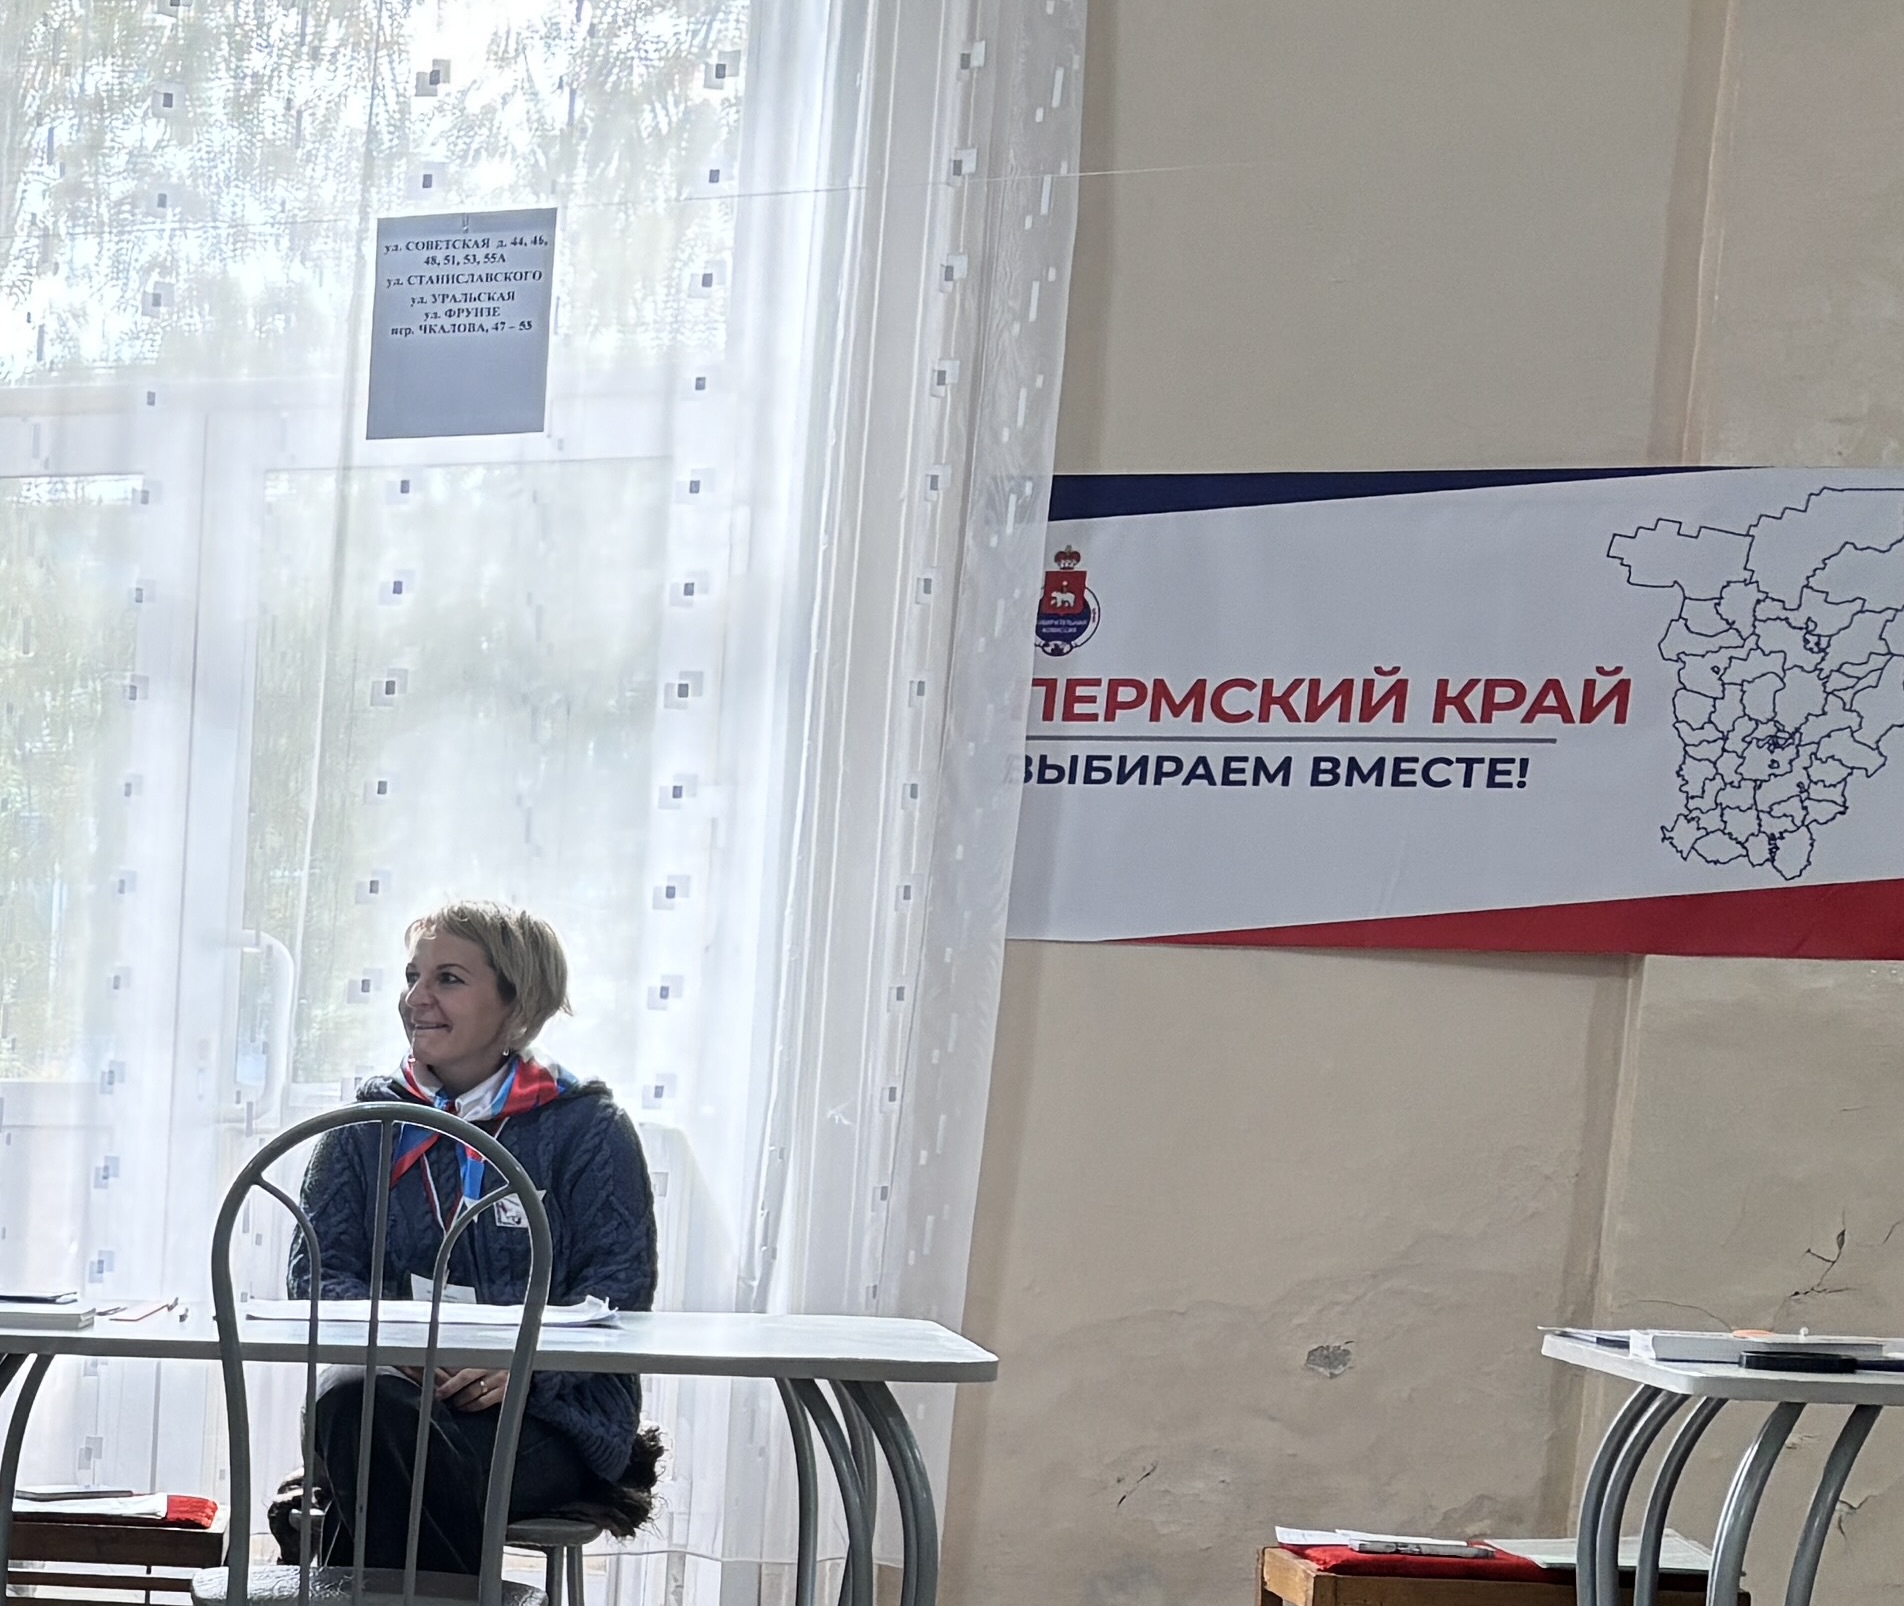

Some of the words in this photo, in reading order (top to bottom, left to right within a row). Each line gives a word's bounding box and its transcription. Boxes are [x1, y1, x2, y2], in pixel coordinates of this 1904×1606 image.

[405, 238, 490, 252] СОВЕТСКАЯ
[407, 270, 543, 286] СТАНИСЛАВСКОГО
[431, 291, 516, 304] УРАЛЬСКАЯ
[444, 306, 501, 319] ФРУНЗЕ
[419, 322, 489, 336] ЧКАЛОВА,
[1431, 665, 1632, 725] КРАЙ
[1309, 756, 1530, 788] ВМЕСТЕ!
